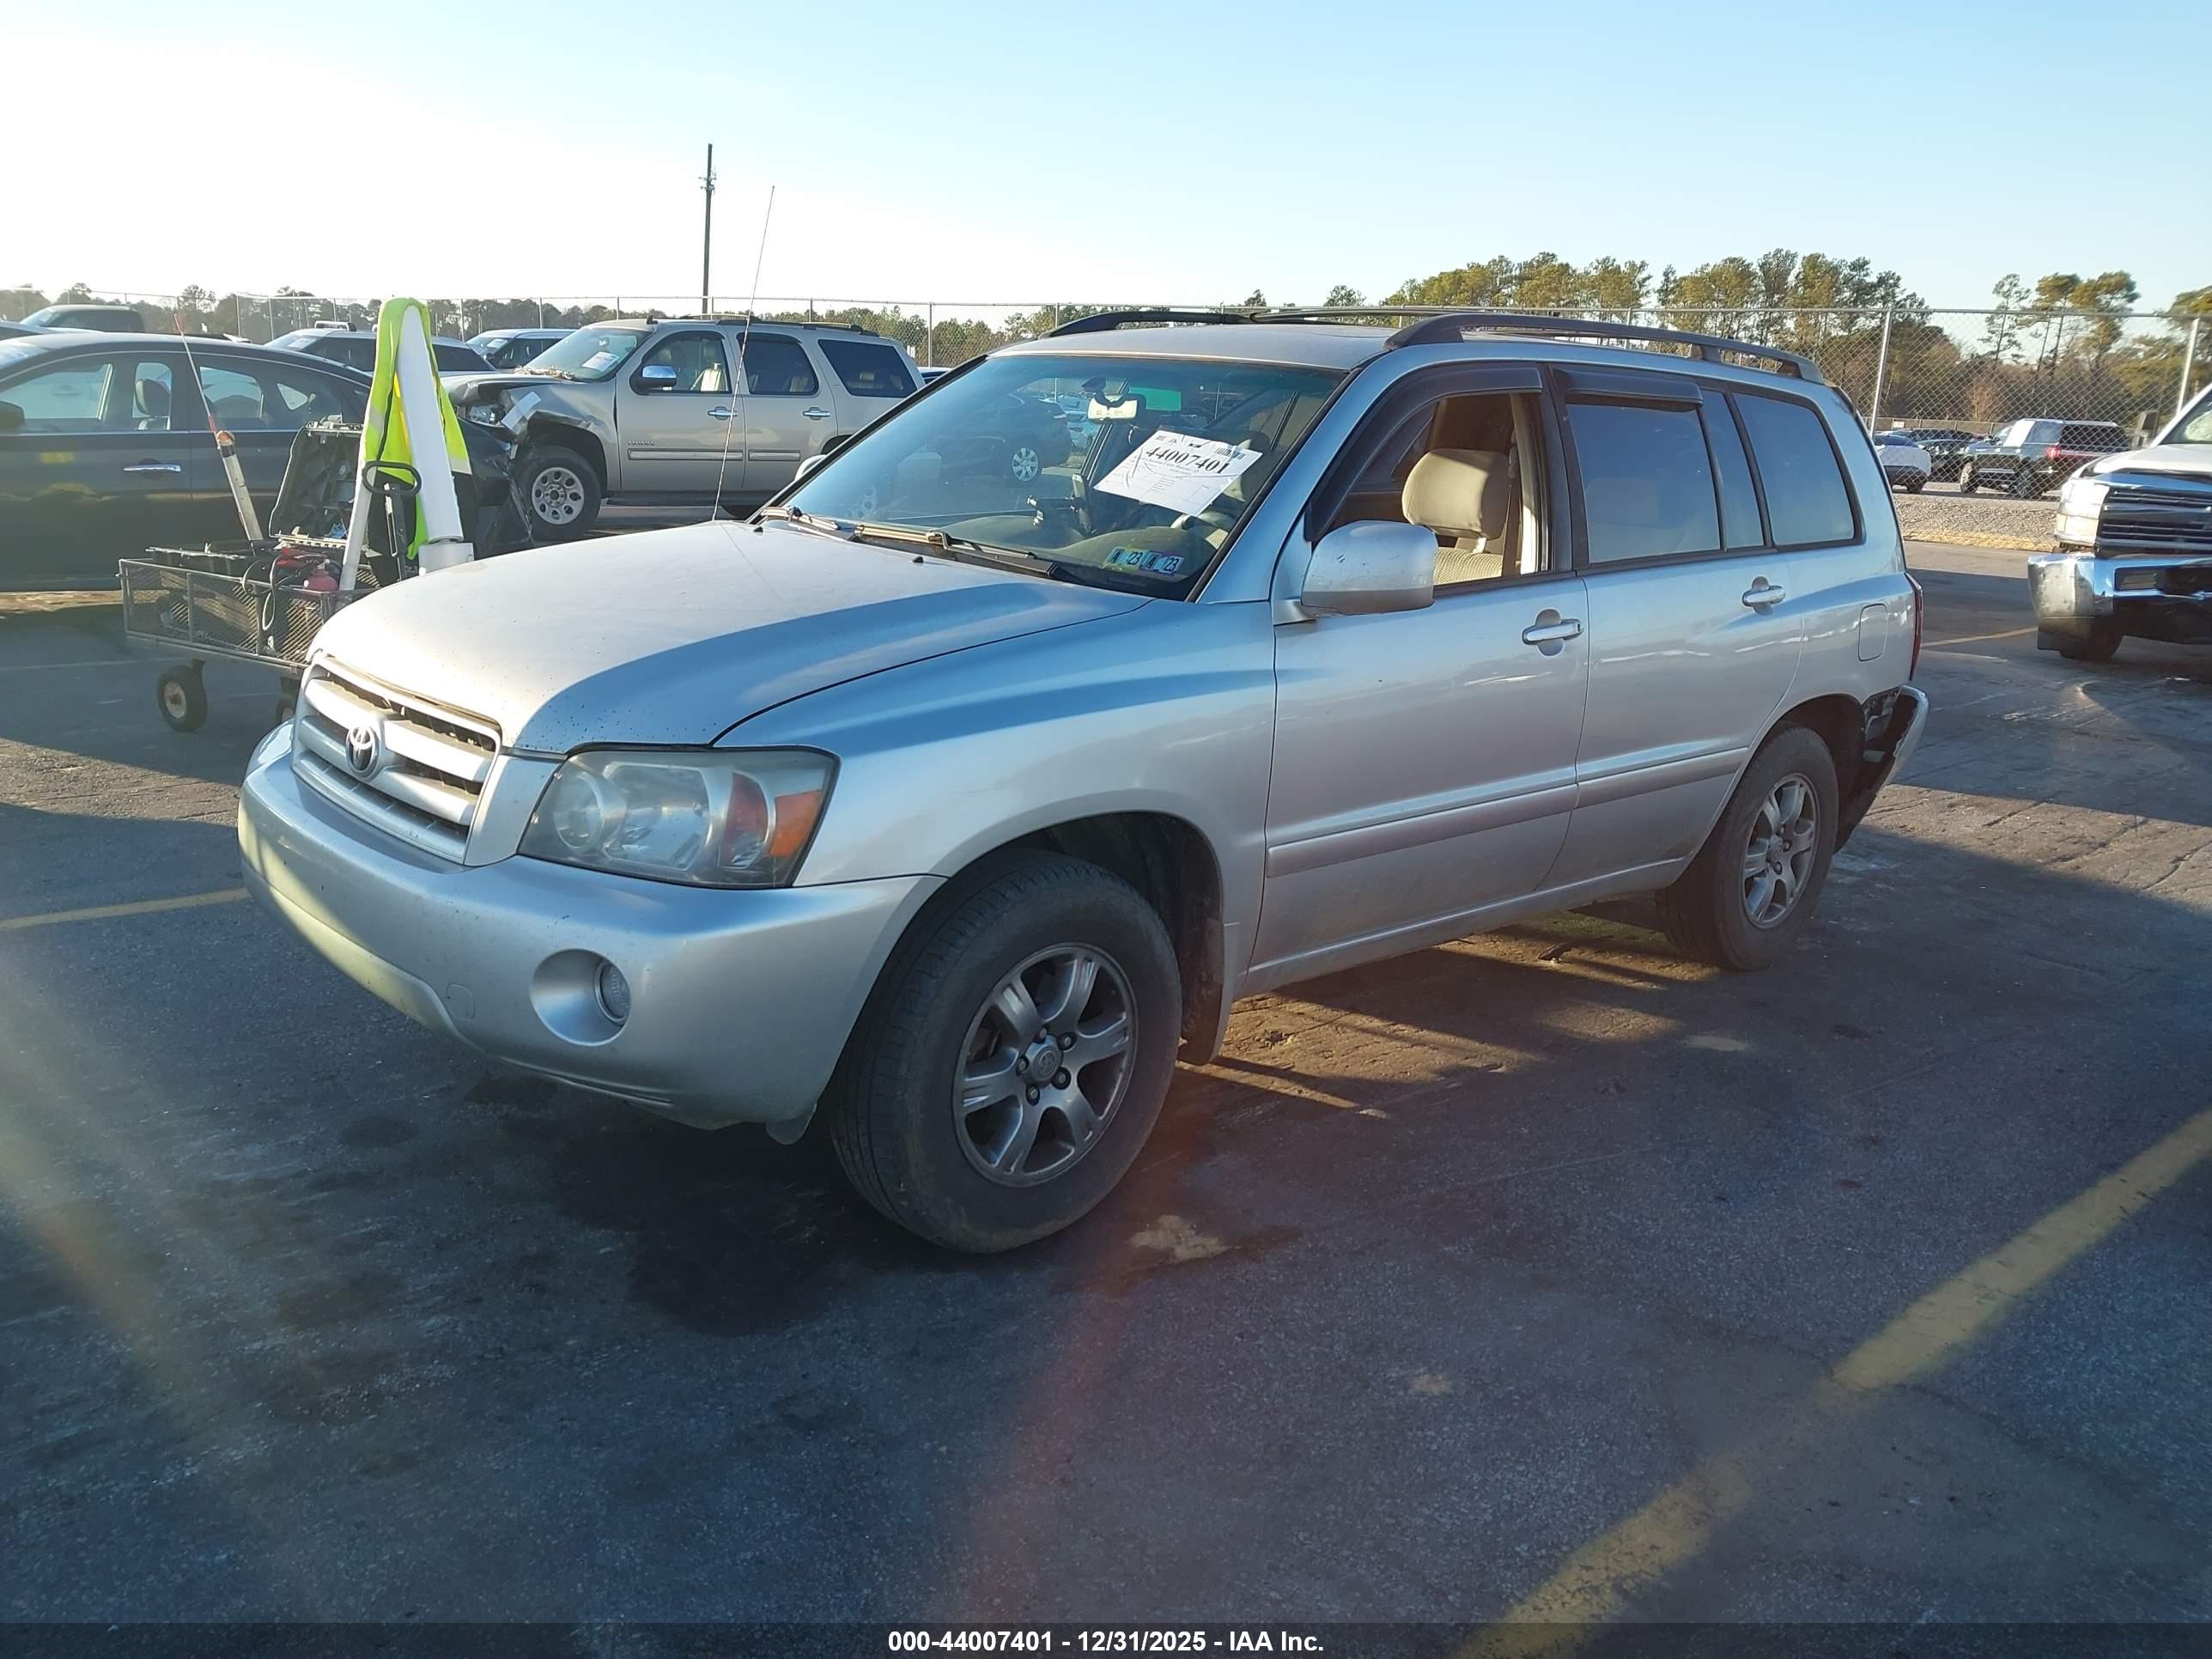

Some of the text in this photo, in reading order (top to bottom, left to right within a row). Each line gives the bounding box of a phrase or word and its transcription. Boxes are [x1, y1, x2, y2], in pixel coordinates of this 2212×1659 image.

[1145, 446, 1231, 474] 44007401
[1127, 551, 1144, 565] 23
[1164, 556, 1180, 572] 23
